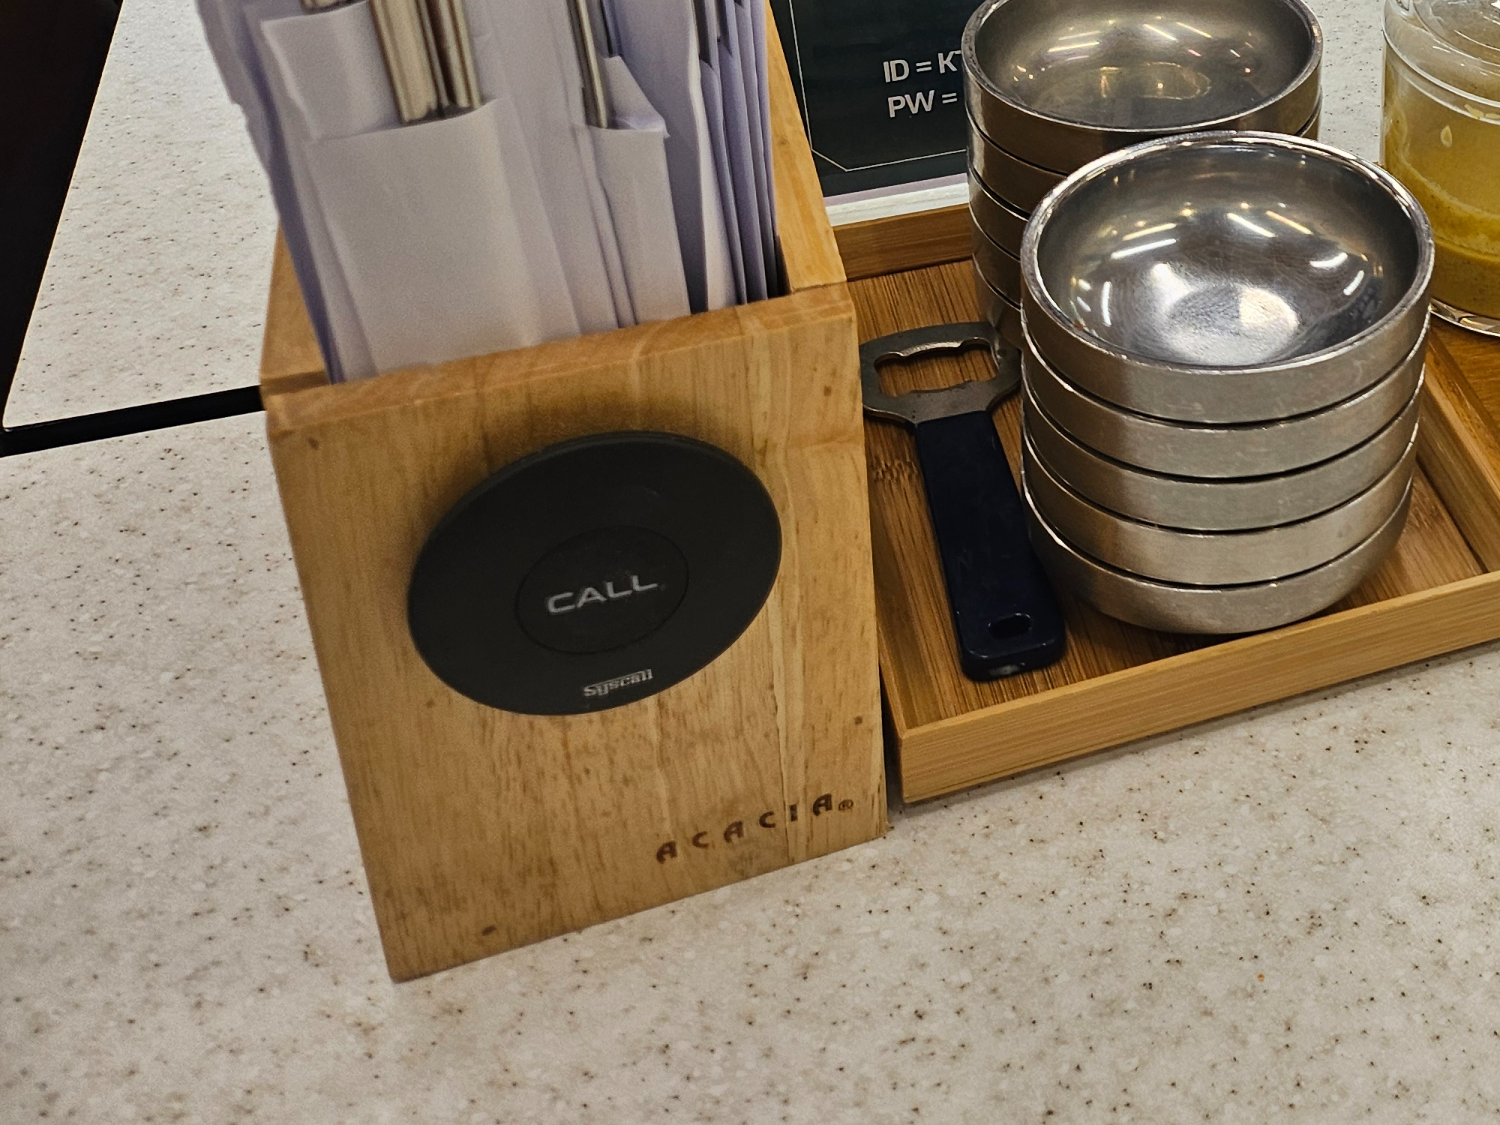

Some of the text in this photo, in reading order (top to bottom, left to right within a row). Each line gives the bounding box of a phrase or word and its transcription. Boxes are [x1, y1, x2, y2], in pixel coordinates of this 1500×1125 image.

[882, 59, 910, 83] ID
[937, 49, 962, 74] K
[887, 89, 935, 118] PW
[545, 574, 659, 615] CALL
[583, 668, 653, 697] Syscall
